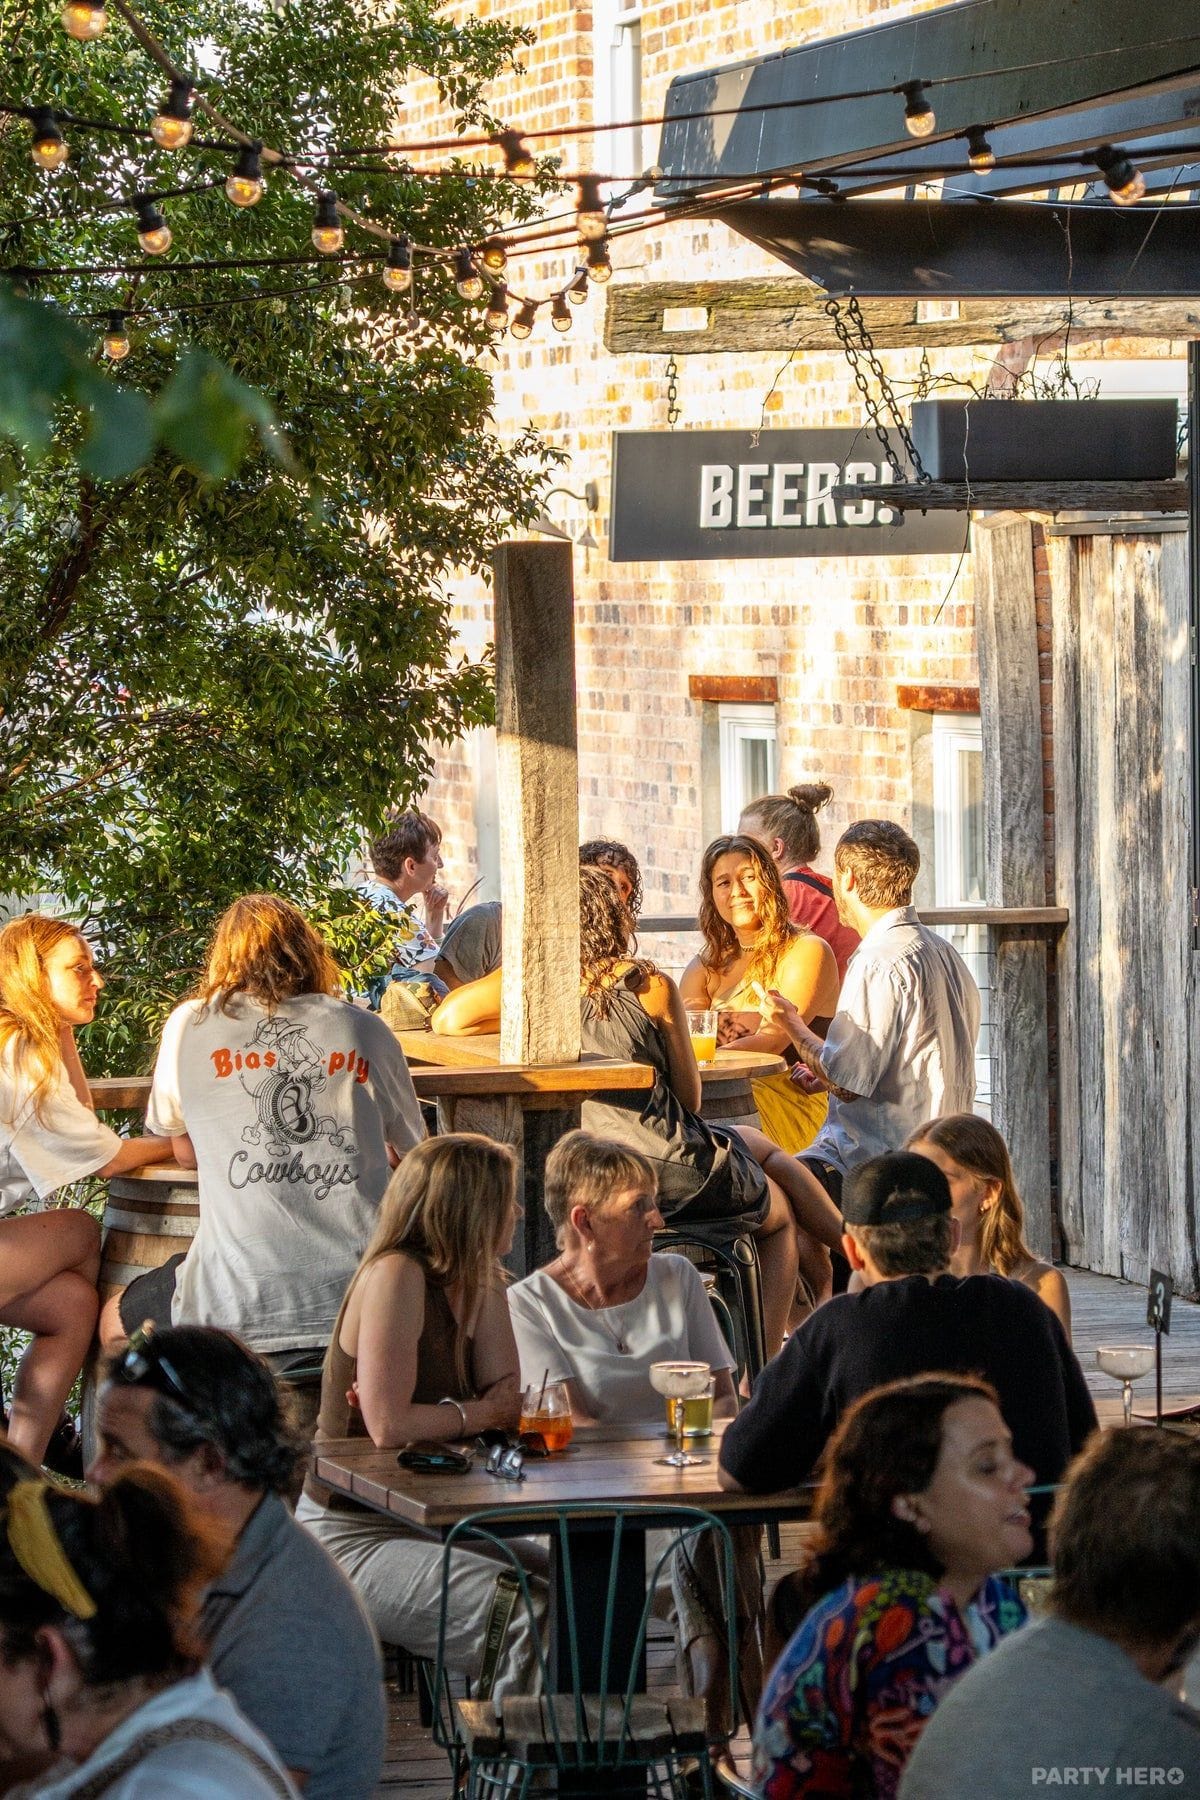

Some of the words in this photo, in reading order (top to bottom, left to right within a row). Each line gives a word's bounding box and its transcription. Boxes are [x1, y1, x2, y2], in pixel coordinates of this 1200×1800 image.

[210, 1048, 276, 1079] Bias
[228, 1150, 360, 1200] Cowboys
[1153, 1281, 1165, 1318] 3
